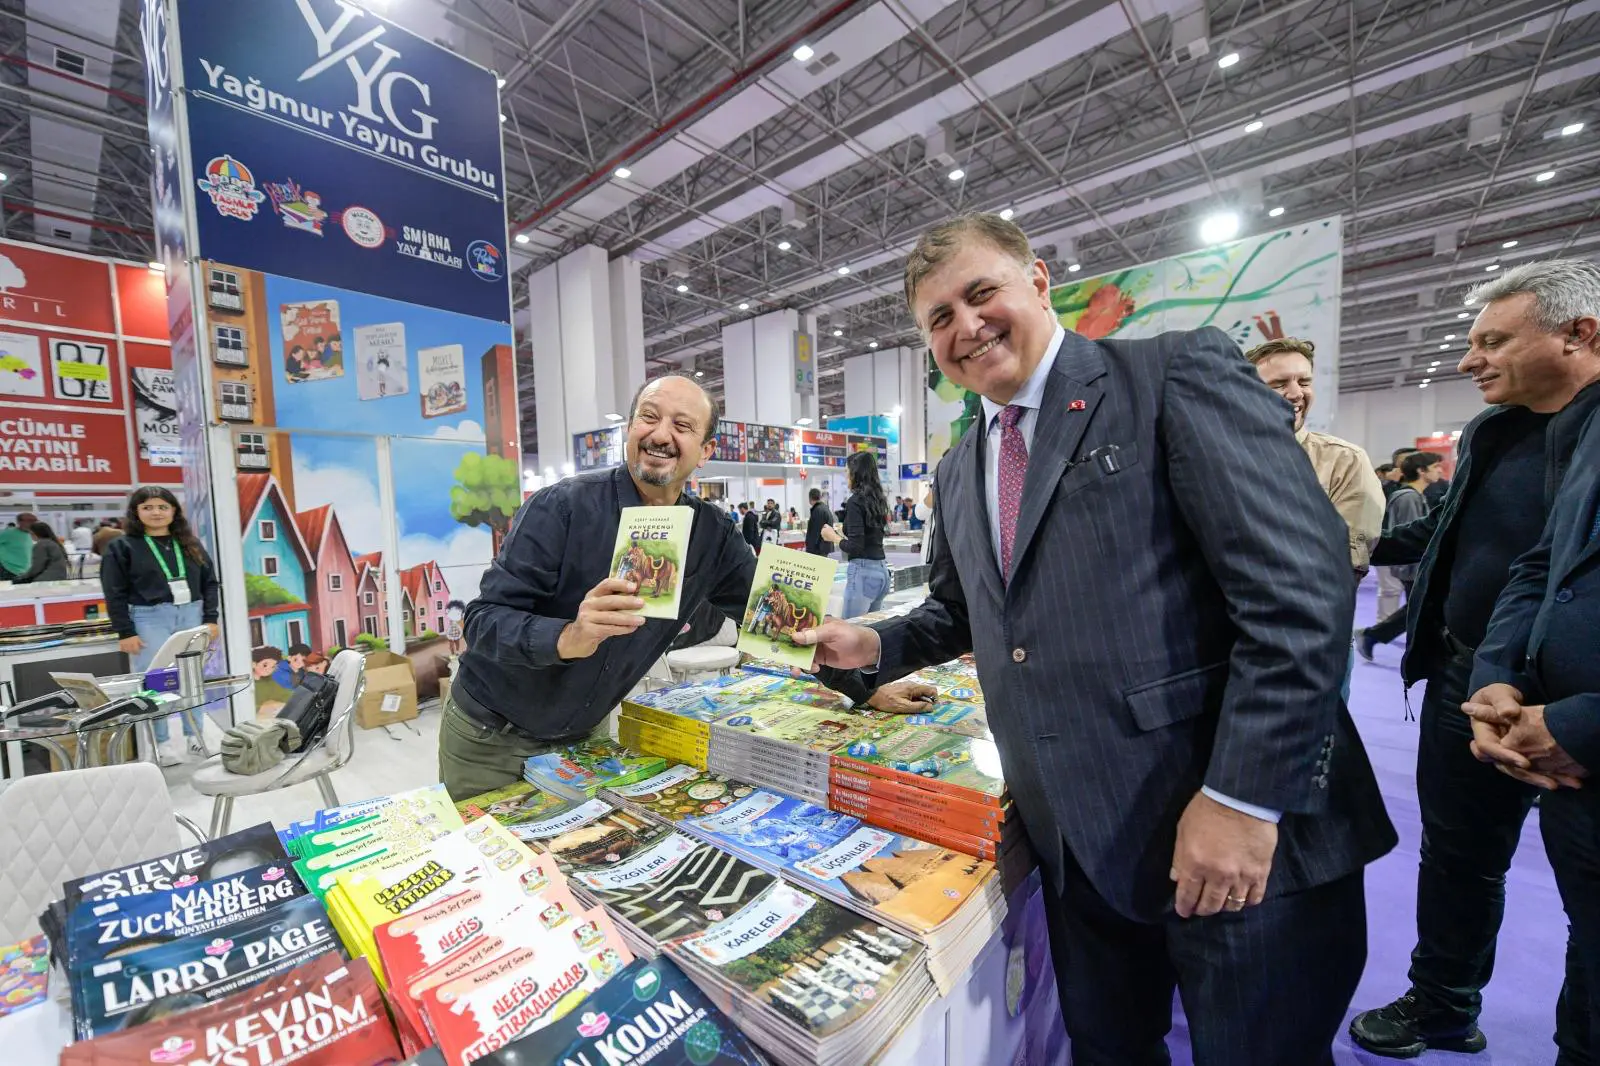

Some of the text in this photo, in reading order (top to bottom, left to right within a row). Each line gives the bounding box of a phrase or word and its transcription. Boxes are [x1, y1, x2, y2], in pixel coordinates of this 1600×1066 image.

[200, 57, 496, 189] Yağmur Yayın Grubu
[0, 417, 87, 439] CÜMLE
[769, 565, 820, 582] KAHVERENGİ
[771, 572, 813, 591] CÜCE
[102, 848, 205, 893] STEVE
[609, 855, 668, 884] ÇİZGİLERİ
[819, 840, 873, 870] ÜÇGENLERİ
[171, 875, 250, 911] MARK
[385, 868, 455, 914] TATLILAR
[98, 879, 295, 944] ZUCKERBERG
[723, 910, 783, 950] KARELERİ
[438, 916, 480, 951] NEFİS
[102, 918, 330, 1012] LARRY PAGE
[492, 977, 534, 1017] NEFİS
[205, 984, 333, 1057] KEVIN
[594, 989, 694, 1066] KOUM
